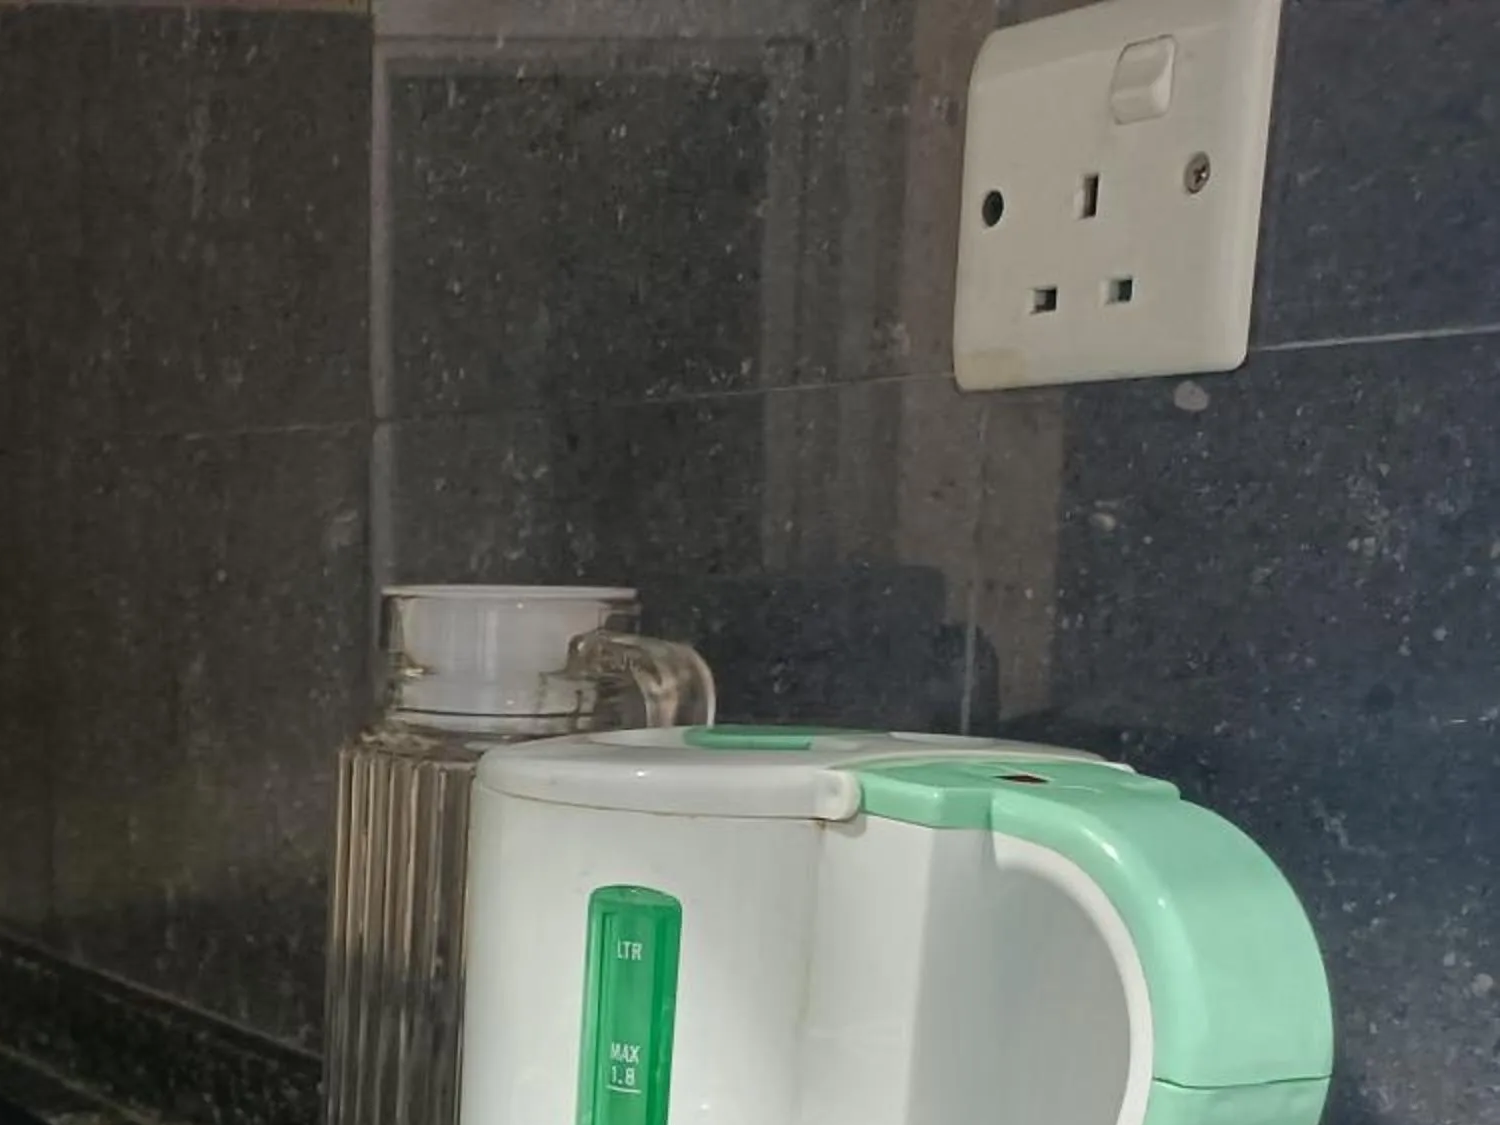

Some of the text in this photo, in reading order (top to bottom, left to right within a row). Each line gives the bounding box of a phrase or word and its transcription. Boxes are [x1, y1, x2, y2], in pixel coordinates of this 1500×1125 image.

[617, 937, 643, 961] LTR
[610, 1042, 641, 1064] MAX
[611, 1065, 636, 1086] 1.8
